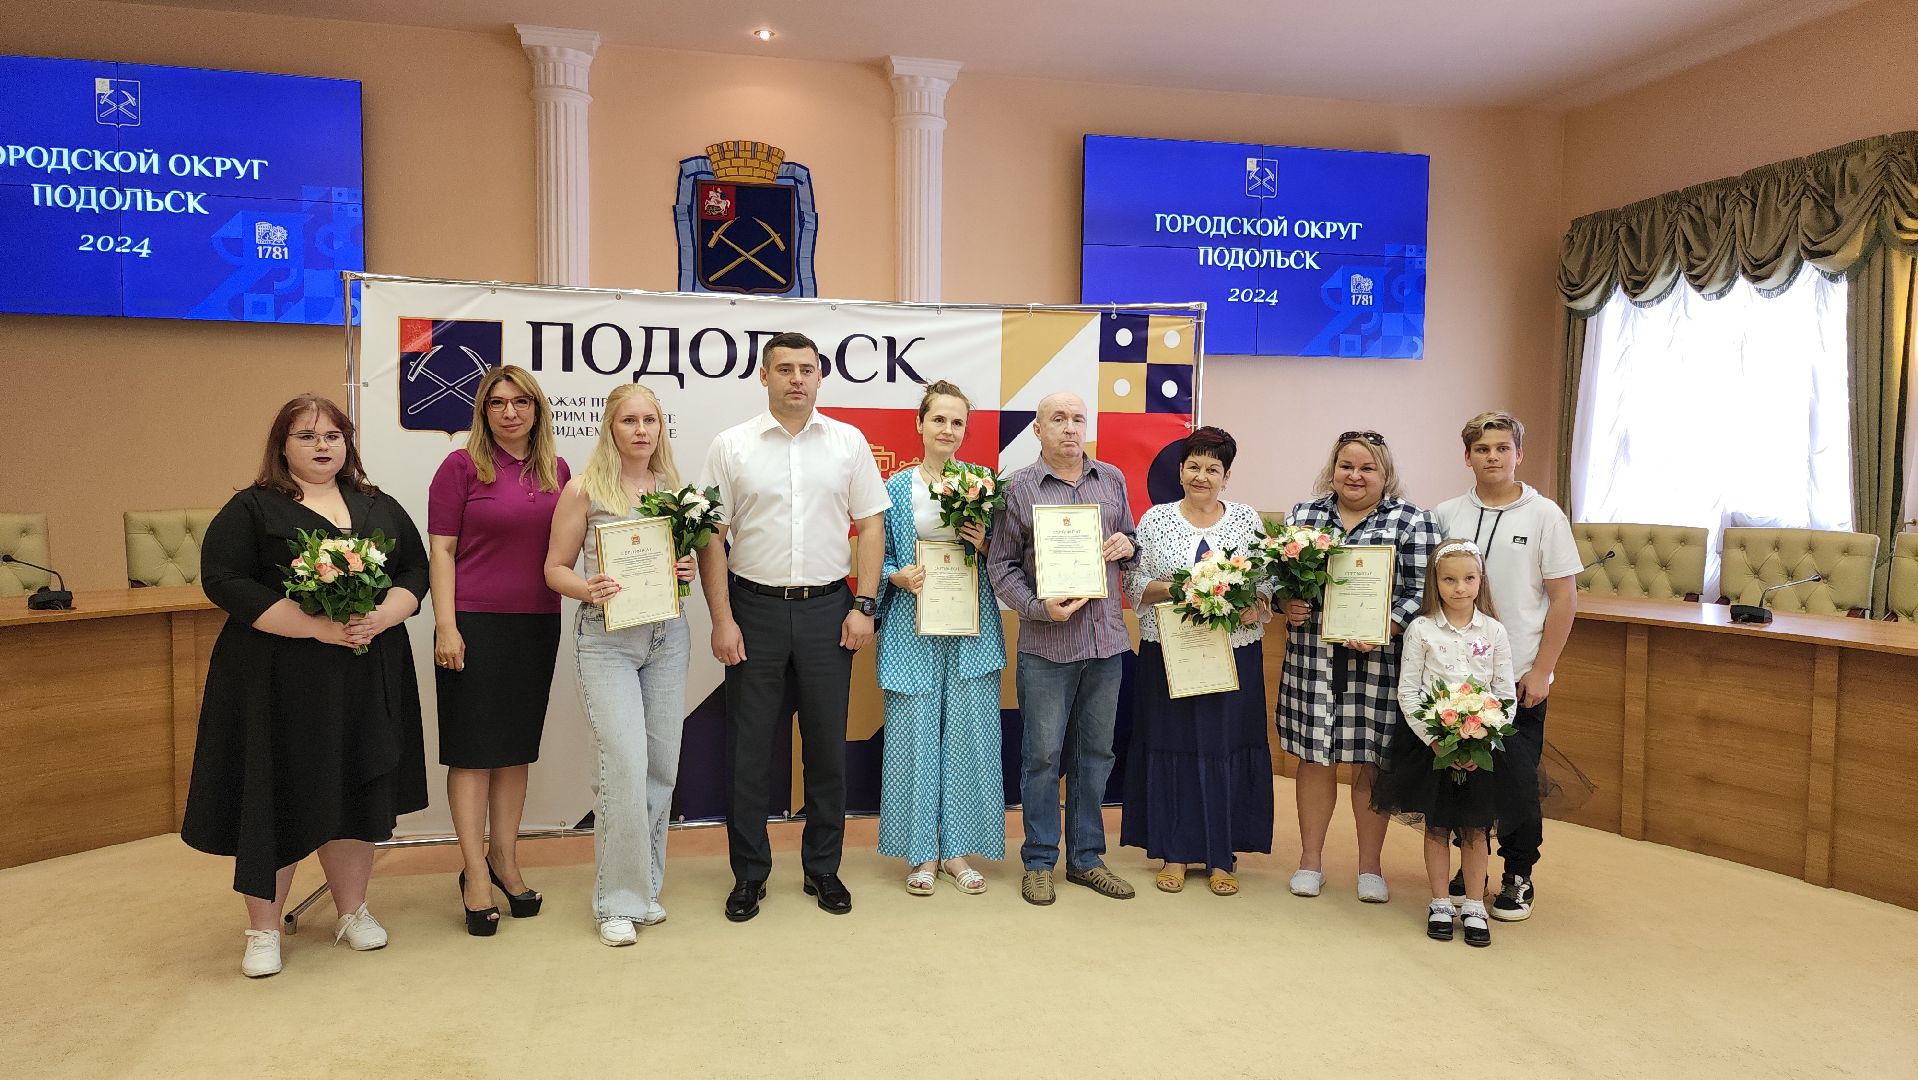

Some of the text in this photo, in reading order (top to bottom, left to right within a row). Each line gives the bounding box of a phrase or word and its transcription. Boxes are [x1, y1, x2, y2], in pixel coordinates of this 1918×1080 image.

[0, 145, 269, 180] РОДСКОЙ ОКРУГ
[31, 183, 210, 214] ПОДОЛЬСК
[1154, 213, 1363, 240] ГОРОДСКОЙ ОКРУГ
[78, 234, 152, 258] 2024
[256, 246, 289, 260] 1781
[1198, 246, 1321, 270] ПОДОЛЬСК
[1227, 287, 1279, 306] 2024
[1350, 294, 1373, 306] 1781
